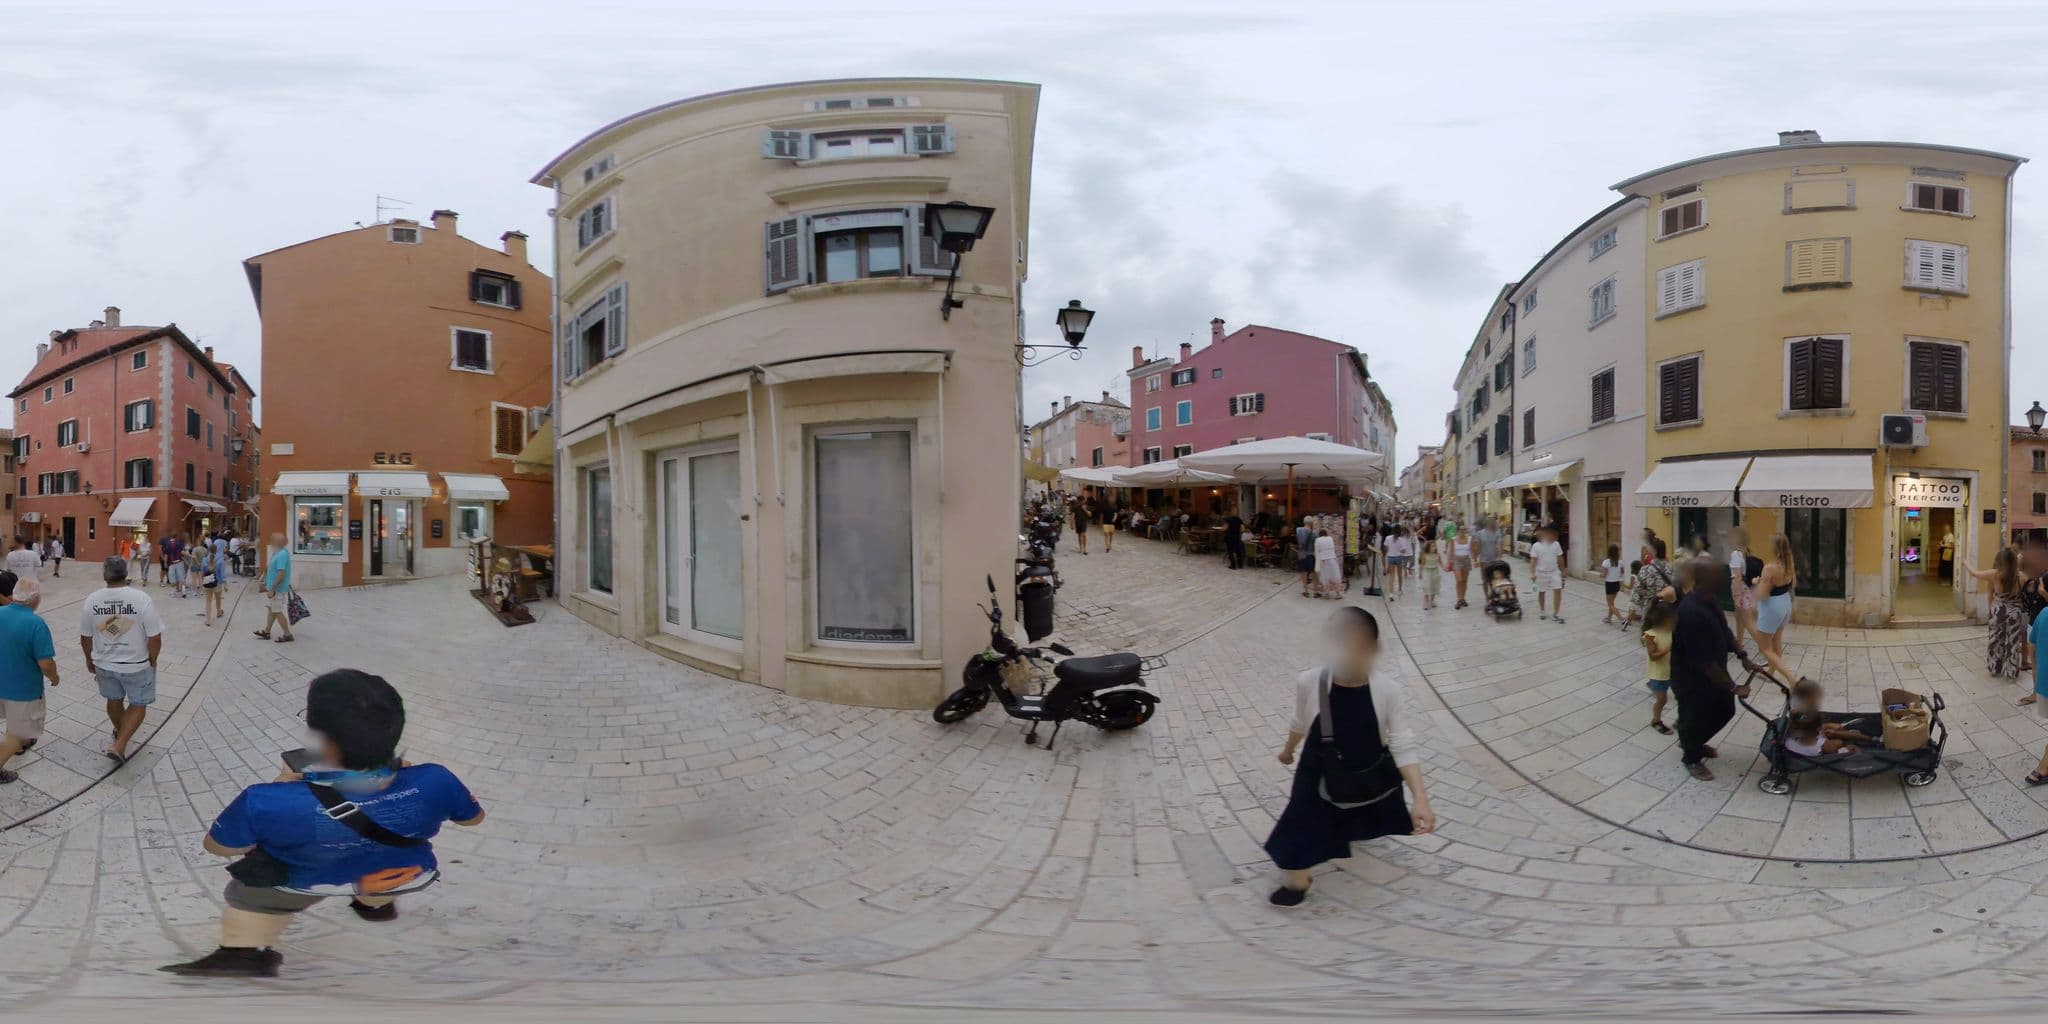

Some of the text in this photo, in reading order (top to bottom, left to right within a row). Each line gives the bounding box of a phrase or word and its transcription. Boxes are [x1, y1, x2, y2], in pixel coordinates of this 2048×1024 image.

[1900, 483, 1960, 494] TATTOO
[1662, 495, 1699, 506] Ristoro
[1780, 494, 1830, 506] Ristoro
[1900, 494, 1960, 502] PIERCING
[92, 603, 138, 615] Small Talk.
